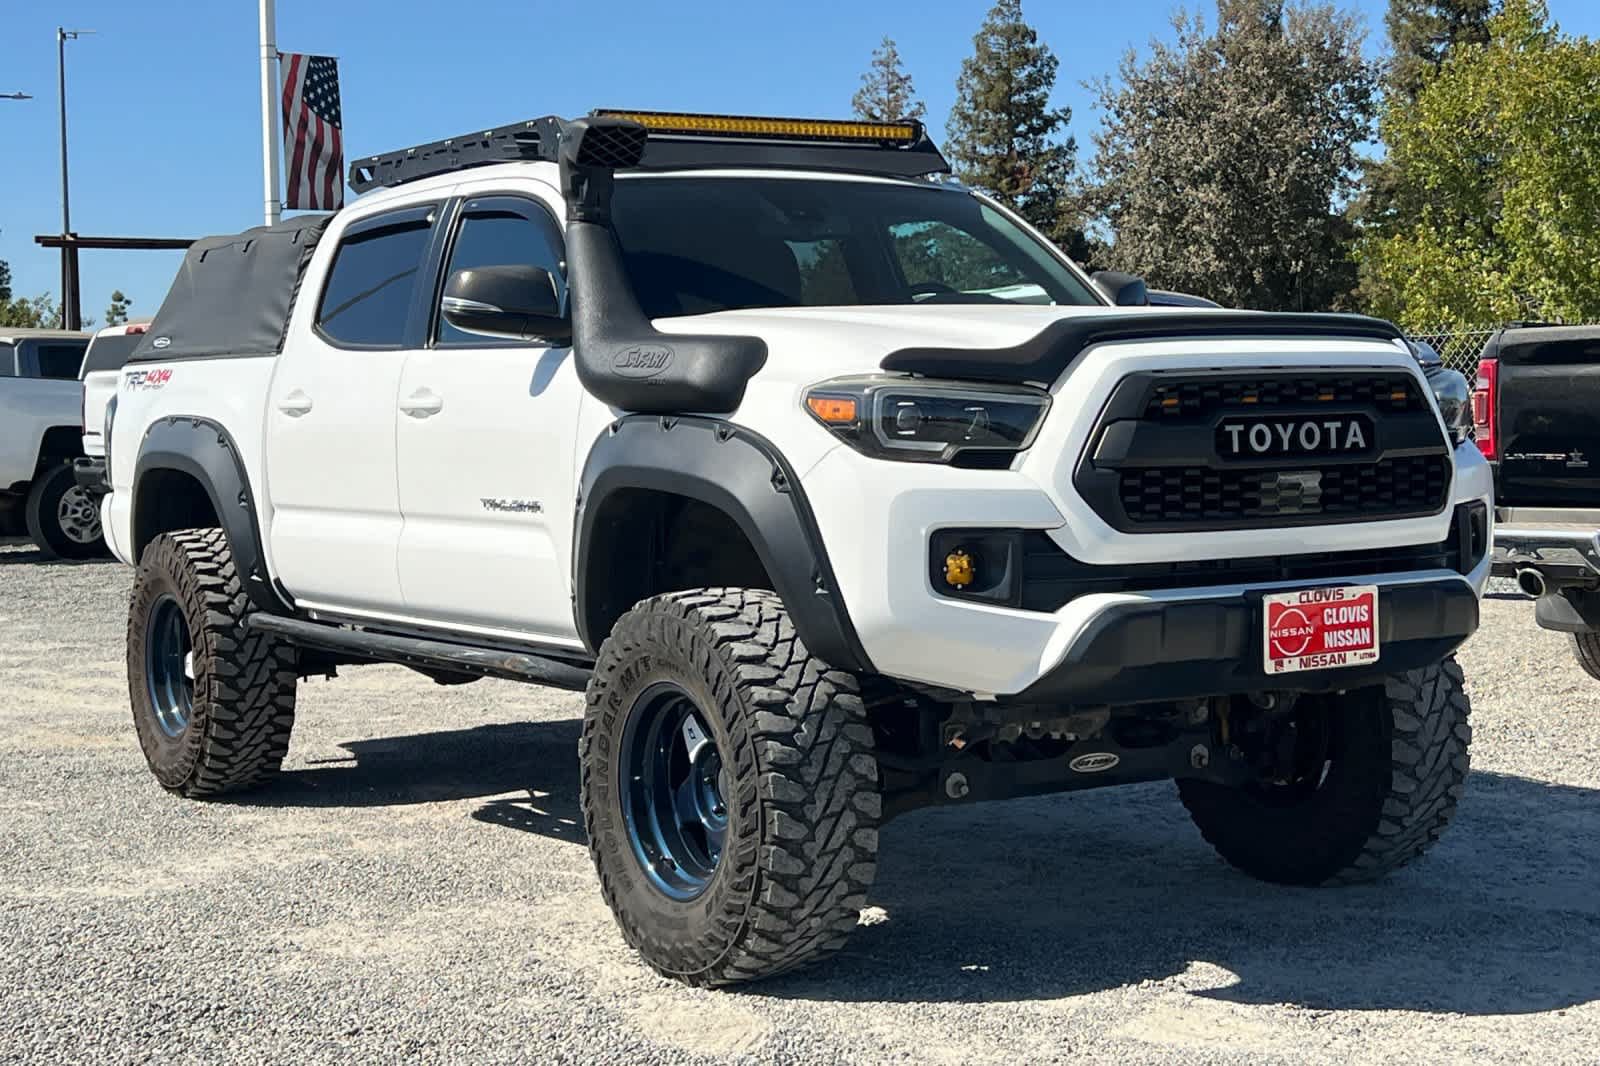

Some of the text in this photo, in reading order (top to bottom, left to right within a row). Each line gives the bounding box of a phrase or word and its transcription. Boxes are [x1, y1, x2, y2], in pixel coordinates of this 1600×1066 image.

[1224, 421, 1366, 453] TOYOTA
[1299, 588, 1345, 604] CLOVIS
[1323, 605, 1369, 626] CLOVIS
[1270, 626, 1314, 638] NISSAN
[1323, 627, 1371, 649] NISSAN
[1299, 652, 1347, 669] NISSAN
